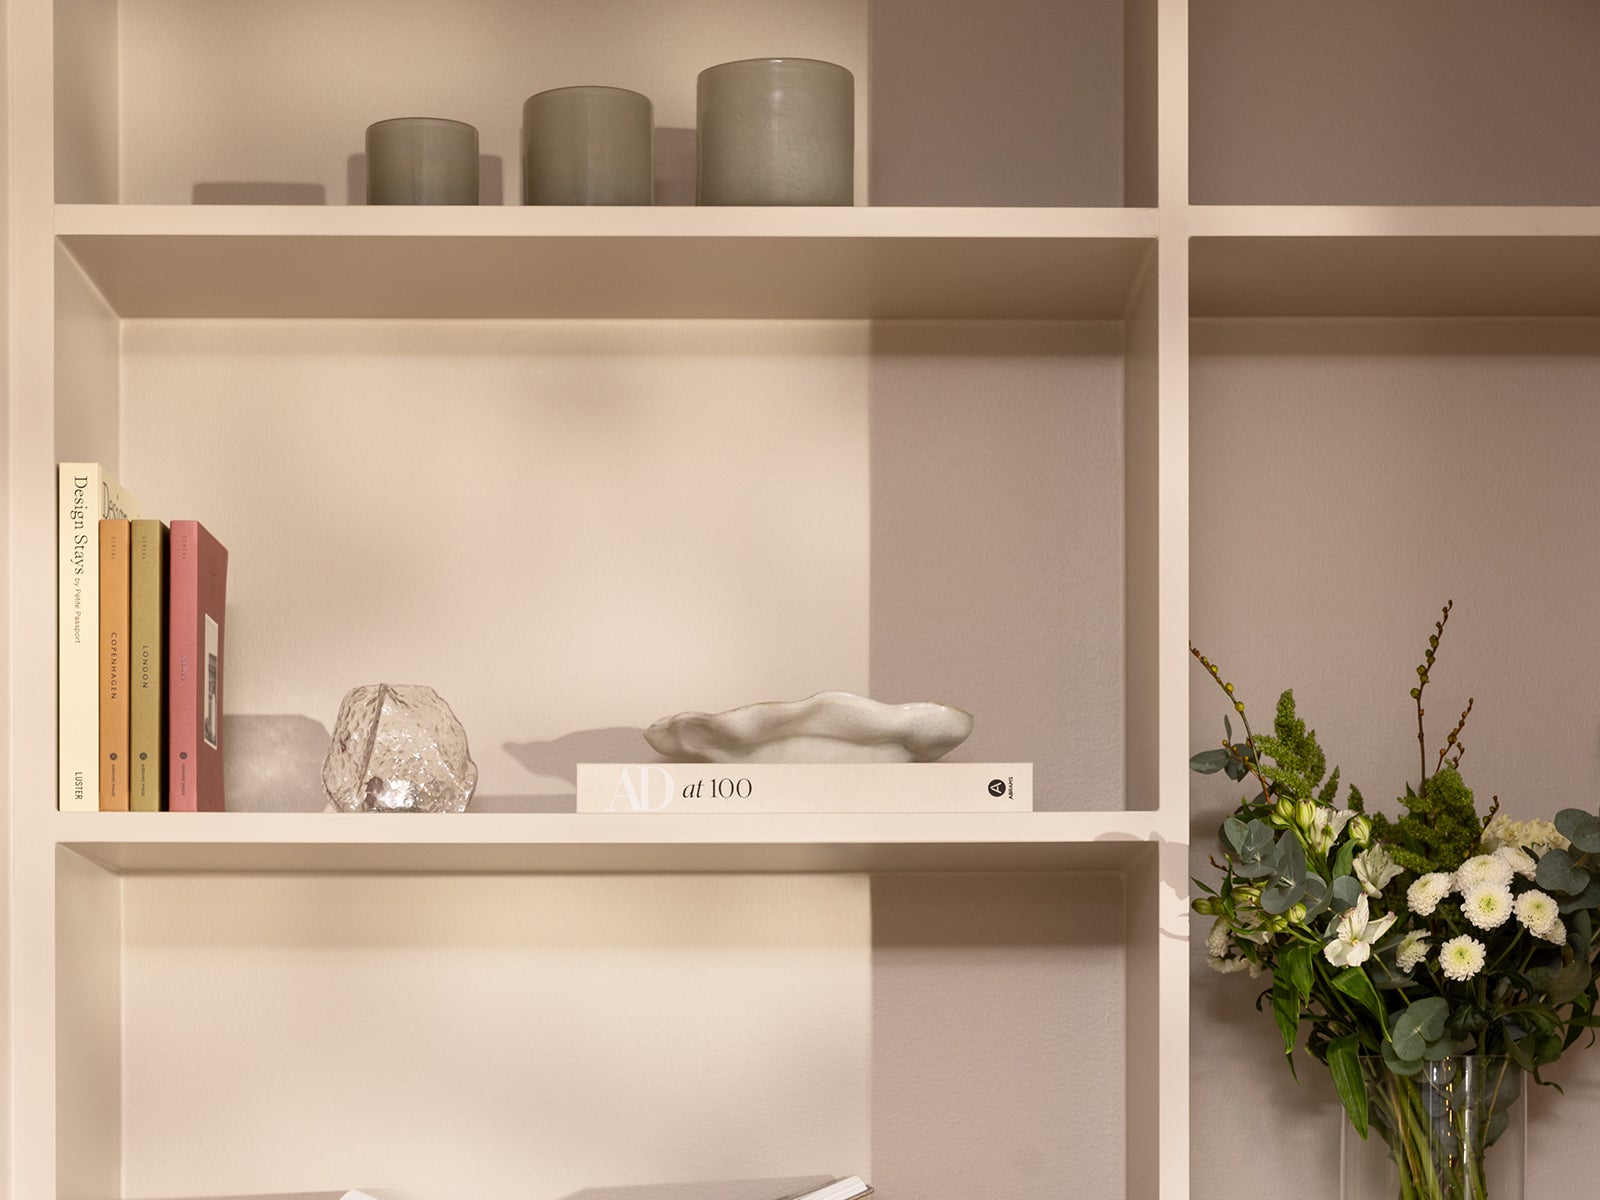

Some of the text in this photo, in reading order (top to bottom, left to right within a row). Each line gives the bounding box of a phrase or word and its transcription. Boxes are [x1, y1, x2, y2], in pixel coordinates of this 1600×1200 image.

[70, 476, 88, 530] Design
[70, 534, 88, 575] Stays
[73, 578, 81, 588] by
[73, 611, 81, 644] Passport
[74, 772, 83, 800] LUSTER
[605, 766, 753, 811] AD at 100
